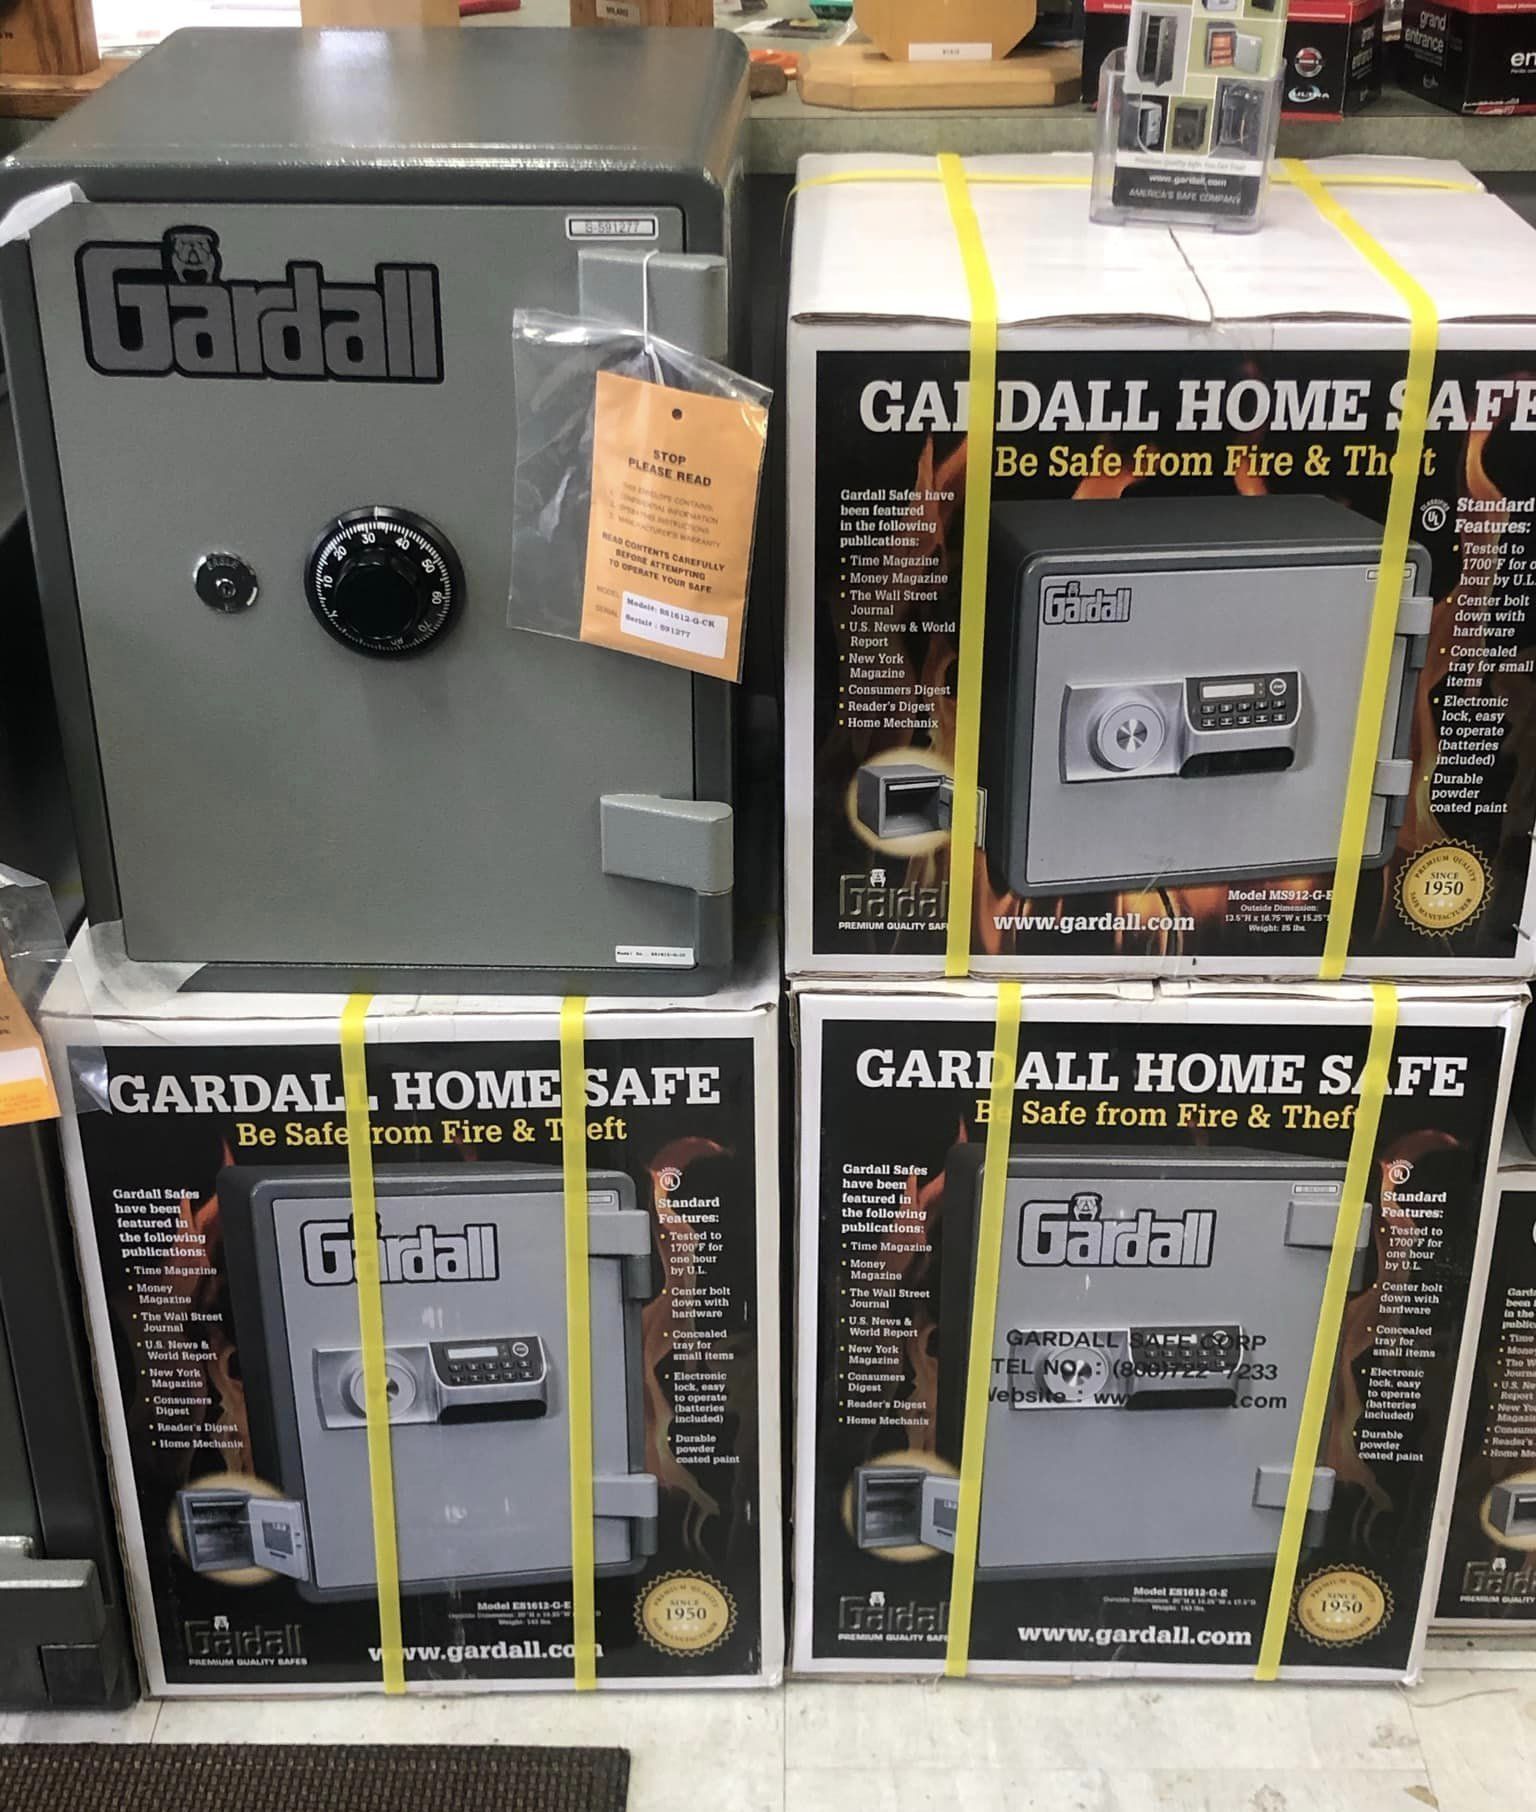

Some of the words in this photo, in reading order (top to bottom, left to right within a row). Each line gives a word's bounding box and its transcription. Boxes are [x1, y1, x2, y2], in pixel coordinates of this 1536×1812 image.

[1420, 10, 1446, 31] grand
[1405, 27, 1445, 53] entrance
[74, 226, 444, 384] Gardall
[1176, 380, 1371, 431] HOME
[653, 449, 686, 465] STOP
[995, 446, 1038, 476] Be
[1048, 444, 1122, 476] Safe
[1131, 444, 1213, 477] from
[1224, 444, 1293, 477] Fire
[1304, 444, 1332, 476] &
[1343, 445, 1437, 476] Tht
[628, 457, 672, 480] PLEASE
[676, 471, 712, 487] READ
[840, 489, 886, 501] Gardall
[889, 489, 922, 501] Safes
[925, 489, 954, 501] have
[840, 504, 869, 516] been
[872, 504, 924, 516] featured
[1456, 497, 1535, 512] Standard
[840, 520, 852, 531] in
[855, 520, 876, 531] the
[878, 520, 937, 534] following
[1454, 518, 1531, 534] Features:
[362, 533, 375, 544] 30
[395, 537, 410, 550] 40
[840, 535, 919, 548] publications:
[602, 531, 623, 545] READ
[624, 540, 669, 560] CONTENTS
[672, 553, 725, 572] CAREFULLY
[1463, 542, 1506, 554] Tested
[1511, 543, 1525, 554] to
[615, 548, 647, 565] BEFORE
[650, 559, 706, 581] ATTEMPTING
[850, 555, 880, 566] Time
[883, 555, 939, 568] Magazine
[1508, 557, 1526, 570] for
[608, 558, 619, 568] TO
[621, 563, 659, 580] OPERATE
[662, 574, 686, 588] YOUR
[688, 582, 712, 593] SAFE
[850, 573, 888, 586] Money
[892, 573, 948, 586] Magazine
[1460, 574, 1490, 586] hour
[1493, 574, 1510, 588] by
[850, 590, 872, 601] The
[875, 589, 900, 601] Wall
[903, 590, 938, 601] Street
[1457, 594, 1501, 606] Center
[1503, 594, 1530, 606] bolt
[1043, 581, 1132, 624] Gardall
[850, 605, 894, 616] Journal
[1454, 609, 1491, 621] down
[1495, 609, 1525, 622] with
[849, 622, 872, 632] U.S.
[874, 622, 906, 632] News
[922, 622, 956, 633] World
[1452, 625, 1515, 637] hardware
[850, 636, 888, 650] Report
[1450, 645, 1517, 657] Concealed
[849, 653, 875, 664] New
[878, 653, 904, 664] York
[1448, 661, 1473, 675] tray
[1478, 660, 1498, 672] for
[1499, 660, 1534, 672] small
[850, 668, 905, 681] Magazine
[1446, 675, 1482, 687] items
[848, 684, 911, 695] Consumers
[914, 684, 950, 697] Digest
[848, 701, 896, 712] Reader's
[899, 701, 935, 714] Digest
[1443, 695, 1508, 707] Electronic
[848, 717, 880, 728] Home
[883, 717, 939, 729] Mechanix
[1442, 710, 1472, 723] lock,
[1476, 711, 1505, 724] easy
[1440, 725, 1452, 736] to
[1456, 725, 1505, 739] operate
[1438, 739, 1499, 752] (batteries
[1436, 754, 1495, 767] included)
[1433, 773, 1483, 785] Durable
[1431, 788, 1480, 801] powder
[1430, 802, 1472, 814] coated
[1475, 802, 1508, 816] paint
[1430, 871, 1459, 880] SINCE
[839, 869, 948, 918] Gardal
[1424, 880, 1464, 896] 1950
[1228, 889, 1266, 901] Model
[838, 921, 884, 931] PREMIUM
[887, 921, 926, 931] QUALITY
[993, 912, 1195, 935] www.gardall.com
[856, 1049, 1119, 1091] GARDALL
[1134, 1053, 1305, 1094] HOME
[391, 1069, 561, 1111] HOME
[584, 1066, 720, 1107] SAFE
[1022, 1100, 1086, 1126] Safe
[1096, 1101, 1167, 1126] from
[1177, 1103, 1238, 1128] Fire
[1248, 1104, 1271, 1128] &
[236, 1122, 276, 1146] Be
[285, 1121, 349, 1147] Safe
[441, 1119, 503, 1144] Fire
[512, 1118, 536, 1143] &
[545, 1116, 628, 1142] Teft
[1017, 1192, 1217, 1267] Gardall
[300, 1212, 500, 1286] Grdall
[1006, 1329, 1119, 1348] GARDALL
[991, 1358, 1033, 1375] TEL
[666, 1607, 707, 1620] 1950
[1321, 1600, 1363, 1614] 1950
[837, 1633, 883, 1642] PREMIUM
[886, 1634, 924, 1643] QUALITY
[1017, 1625, 1252, 1646] www.gardall.com
[188, 1657, 235, 1667] PREMIUM
[237, 1657, 276, 1667] QUALITY
